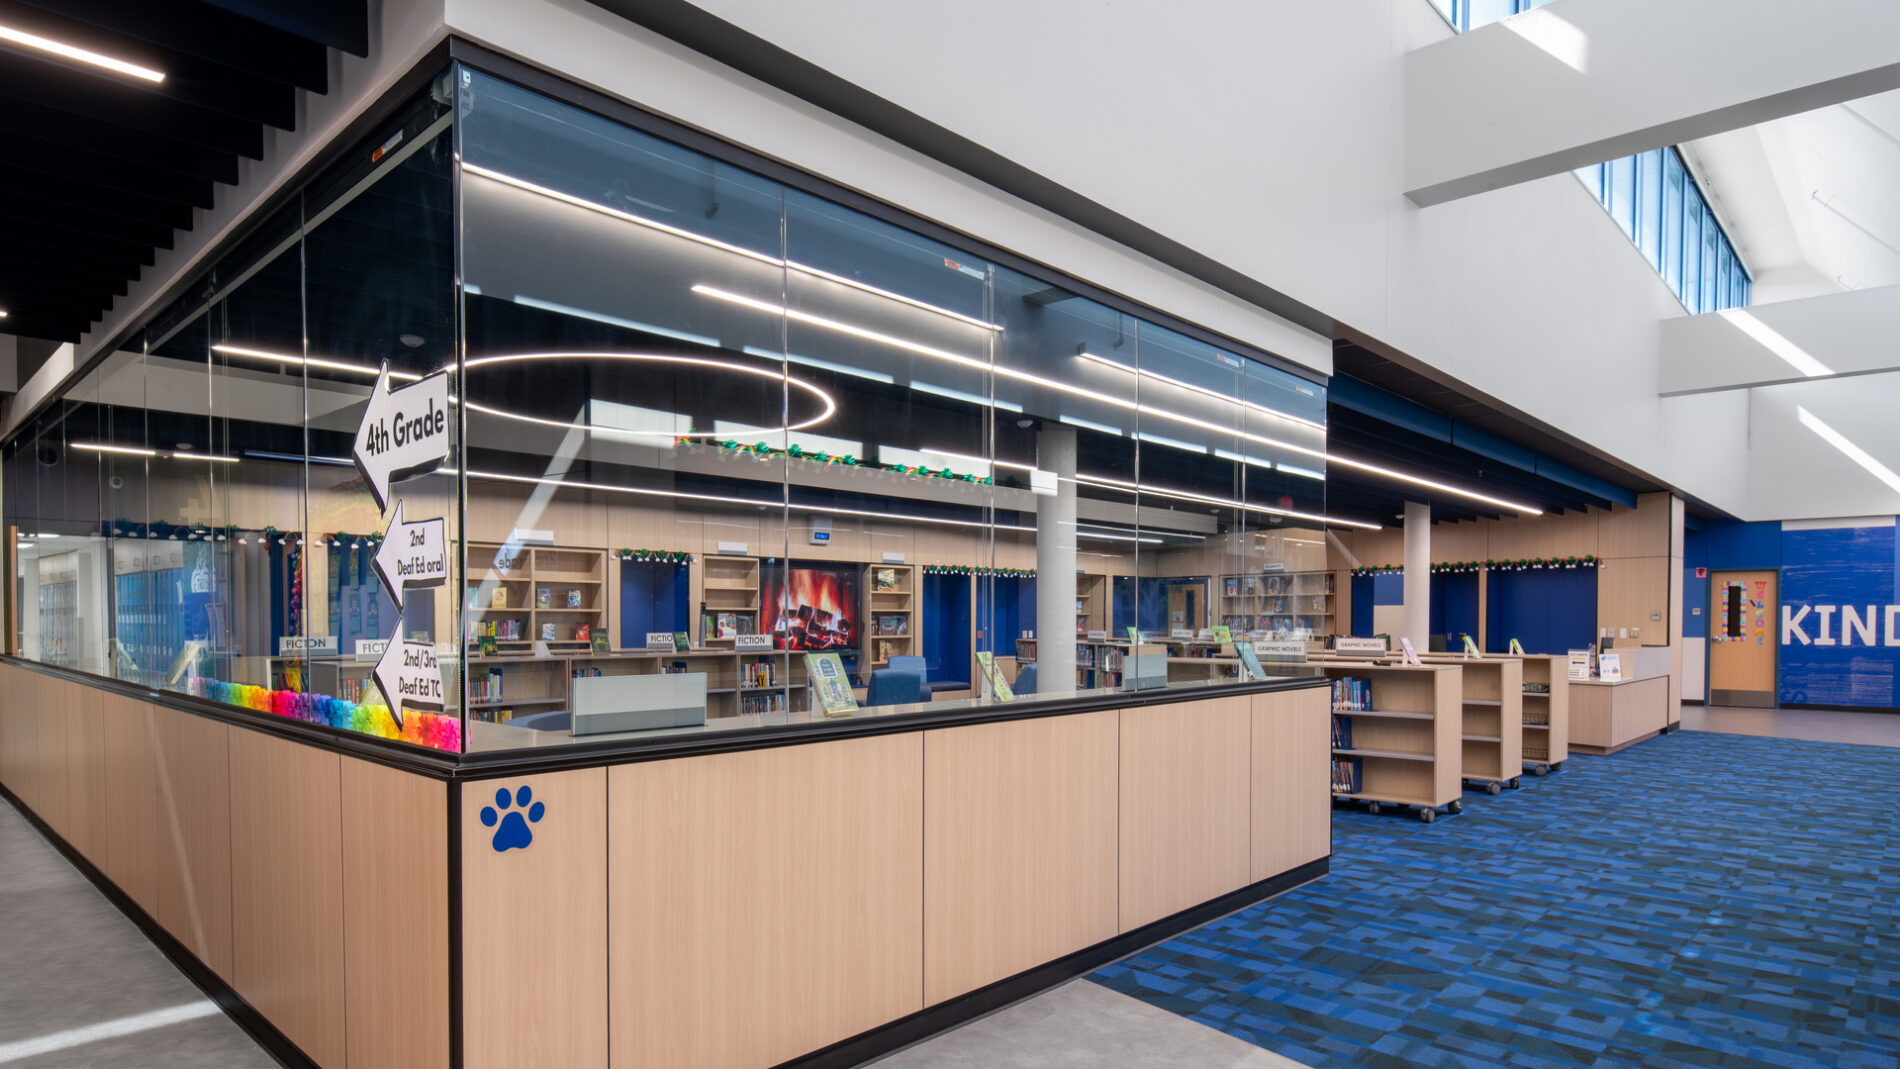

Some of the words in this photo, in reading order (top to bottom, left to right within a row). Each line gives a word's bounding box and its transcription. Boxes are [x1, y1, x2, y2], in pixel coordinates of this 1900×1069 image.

[366, 417, 390, 456] 4th
[393, 397, 444, 448] Grade
[410, 527, 425, 547] 2nd
[397, 557, 414, 576] Deaf
[415, 556, 425, 574] Ed
[427, 553, 444, 573] oral
[286, 638, 327, 649] FICTON
[650, 634, 673, 643] FICTIO
[737, 636, 766, 645] FICTION
[363, 642, 387, 653] FICT
[399, 676, 417, 695] Deaf
[419, 678, 429, 697] Ed
[431, 680, 441, 698] TC
